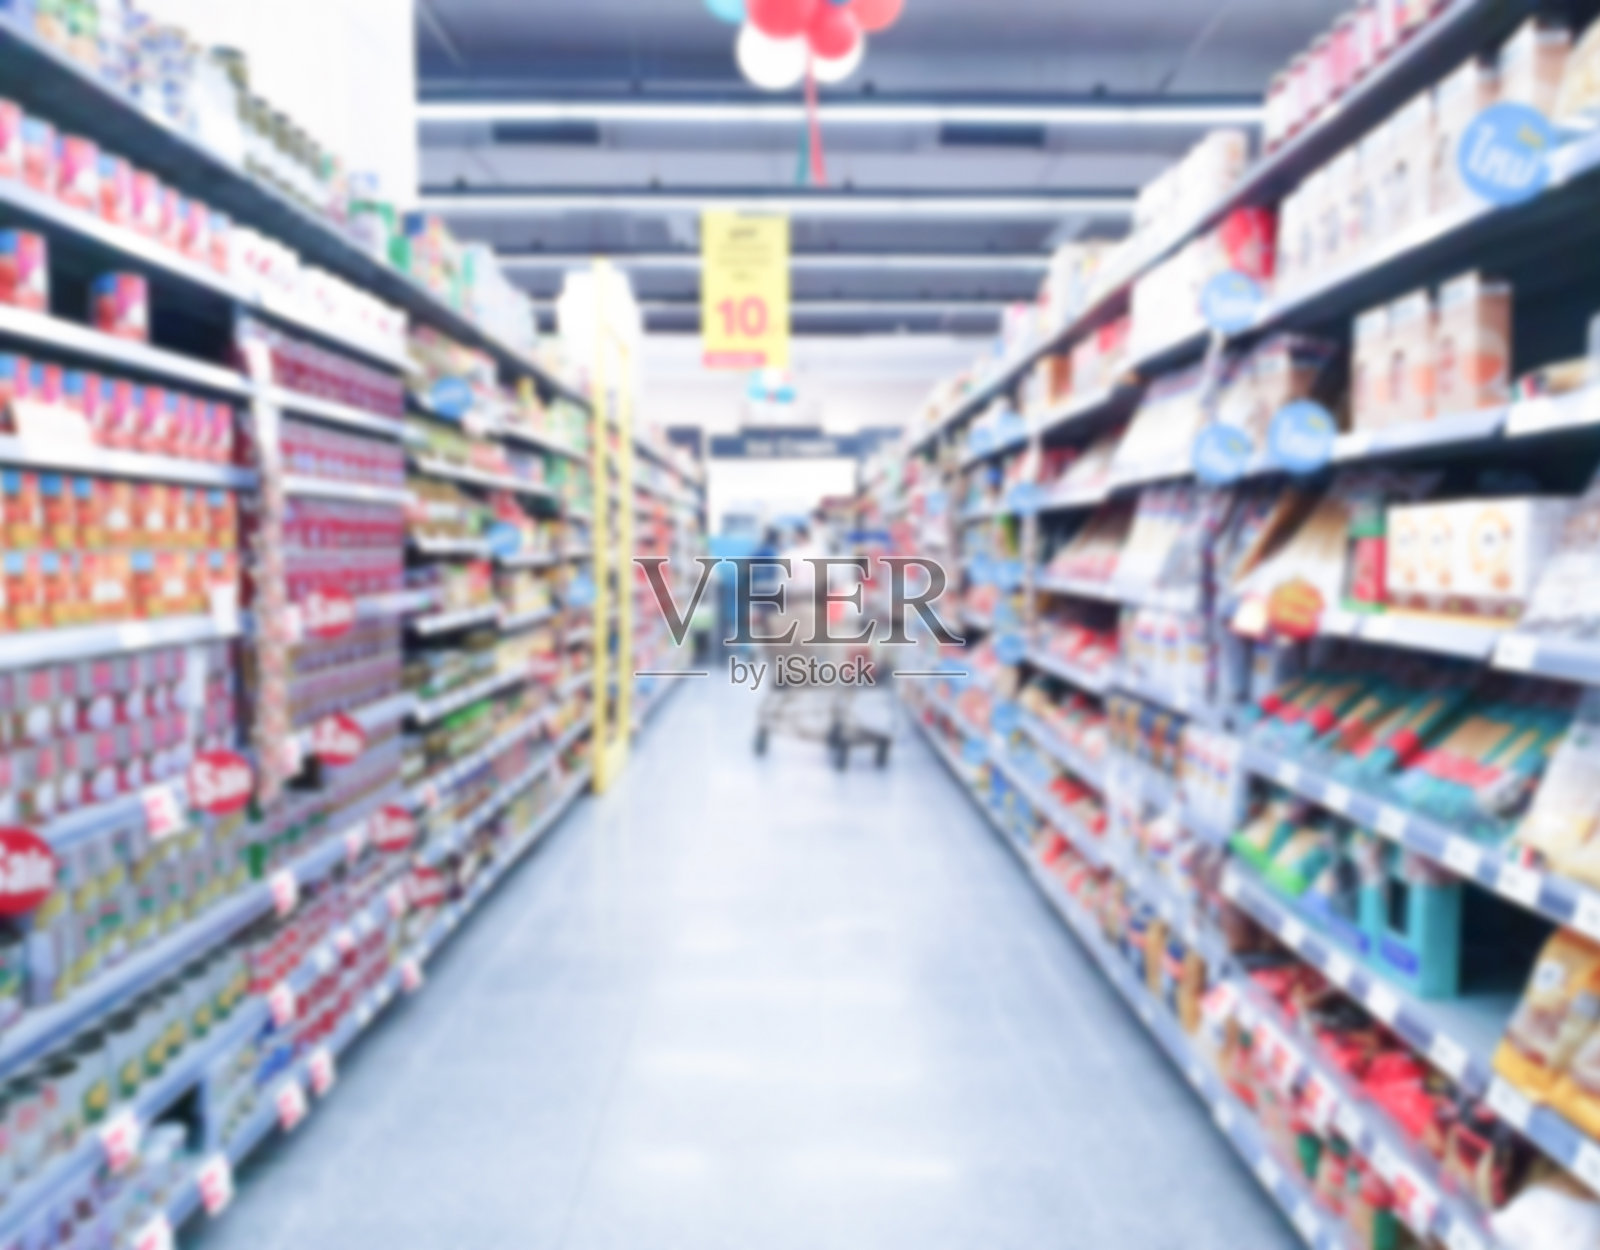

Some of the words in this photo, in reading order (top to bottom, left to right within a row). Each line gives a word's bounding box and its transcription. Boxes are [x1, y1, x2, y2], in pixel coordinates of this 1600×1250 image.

[715, 296, 769, 339] 10
[192, 762, 251, 807] Sale
[0, 840, 53, 893] ale
